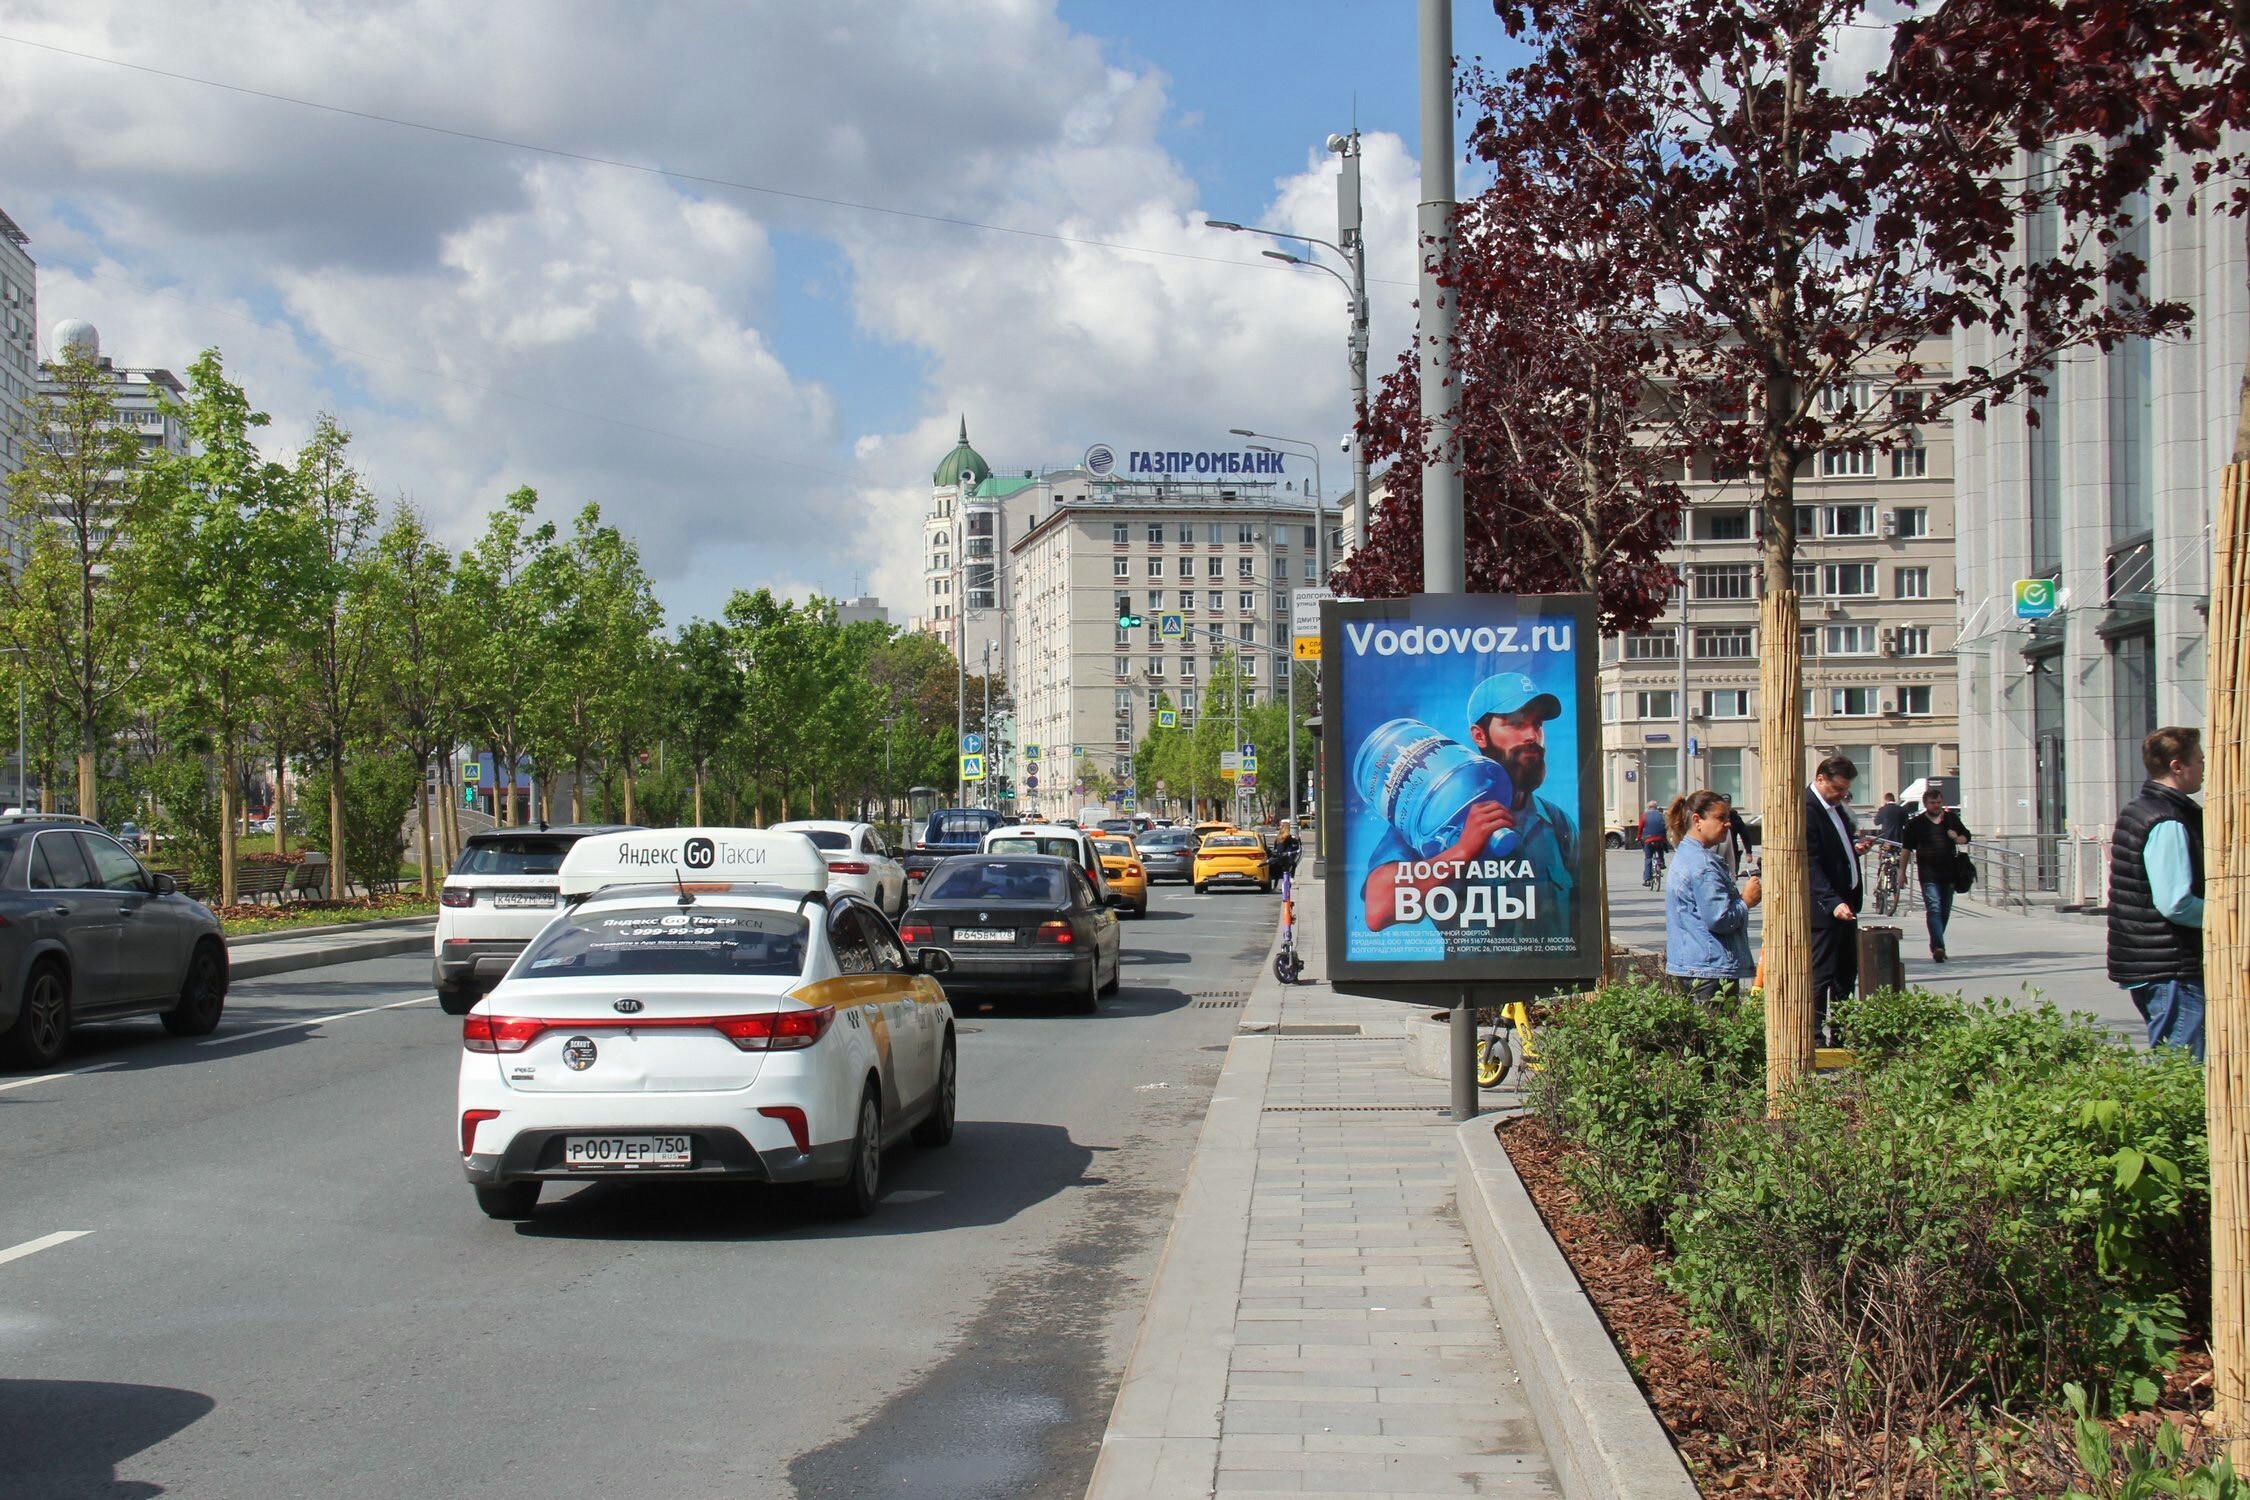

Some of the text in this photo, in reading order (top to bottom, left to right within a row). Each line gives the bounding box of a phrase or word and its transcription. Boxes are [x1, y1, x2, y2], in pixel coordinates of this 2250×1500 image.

[1130, 451, 1285, 474] ГАЗПРОМБАНК
[1296, 616, 1321, 624] ДМИТР
[1346, 622, 1571, 656] Vodovoz.ru
[618, 841, 766, 866] Яндекс Go Такси
[1394, 860, 1536, 884] ДОСТАВКА
[1394, 885, 1536, 928] ВОДЫ
[602, 919, 660, 927] Яндекс
[692, 916, 737, 924] Такси
[632, 927, 715, 936] 999-99-99
[1492, 945, 1533, 953] ПОМЕЩЕНИЕ
[616, 1001, 639, 1011] KIA
[572, 1137, 685, 1160] Р007ЕР 750
